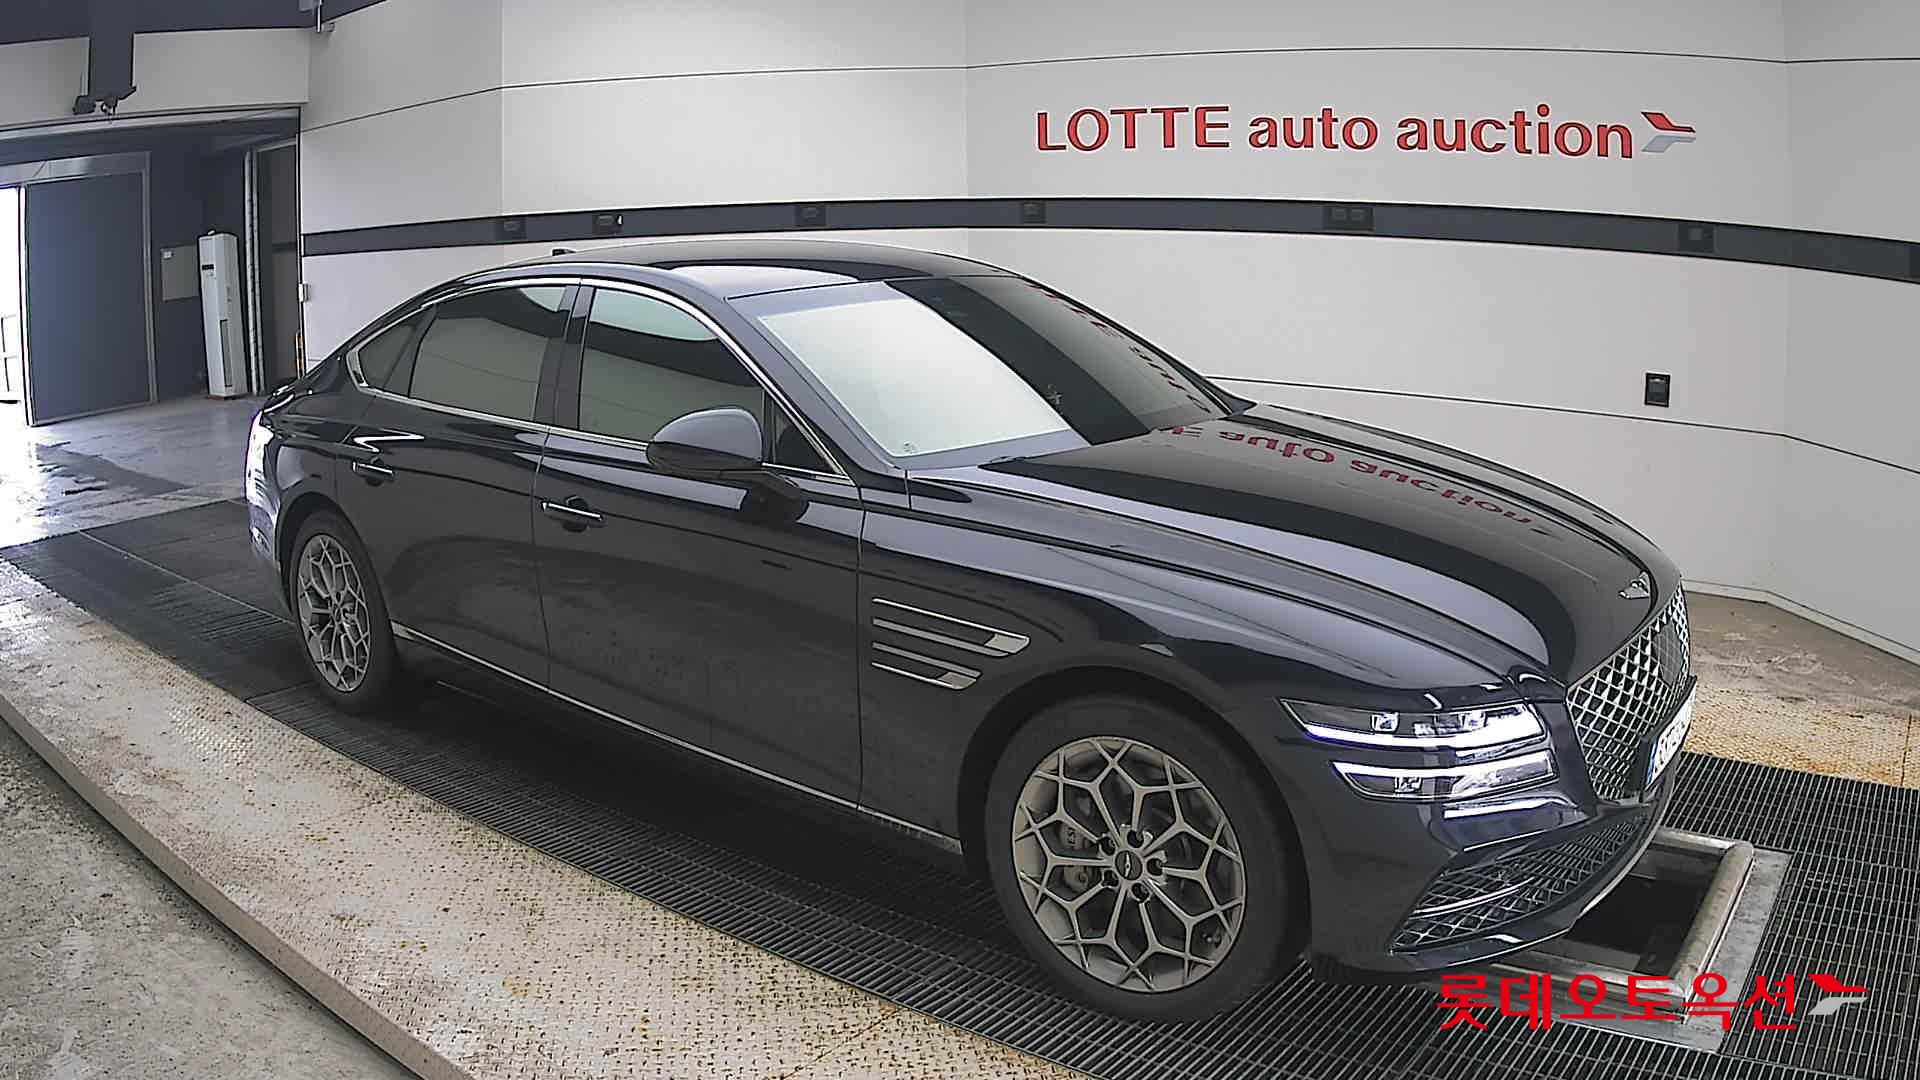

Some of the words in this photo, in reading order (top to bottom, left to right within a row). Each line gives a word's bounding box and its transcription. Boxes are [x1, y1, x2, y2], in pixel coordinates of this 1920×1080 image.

[1037, 105, 1230, 152] LOTTE
[1248, 109, 1379, 151] auto
[1396, 103, 1634, 159] auction
